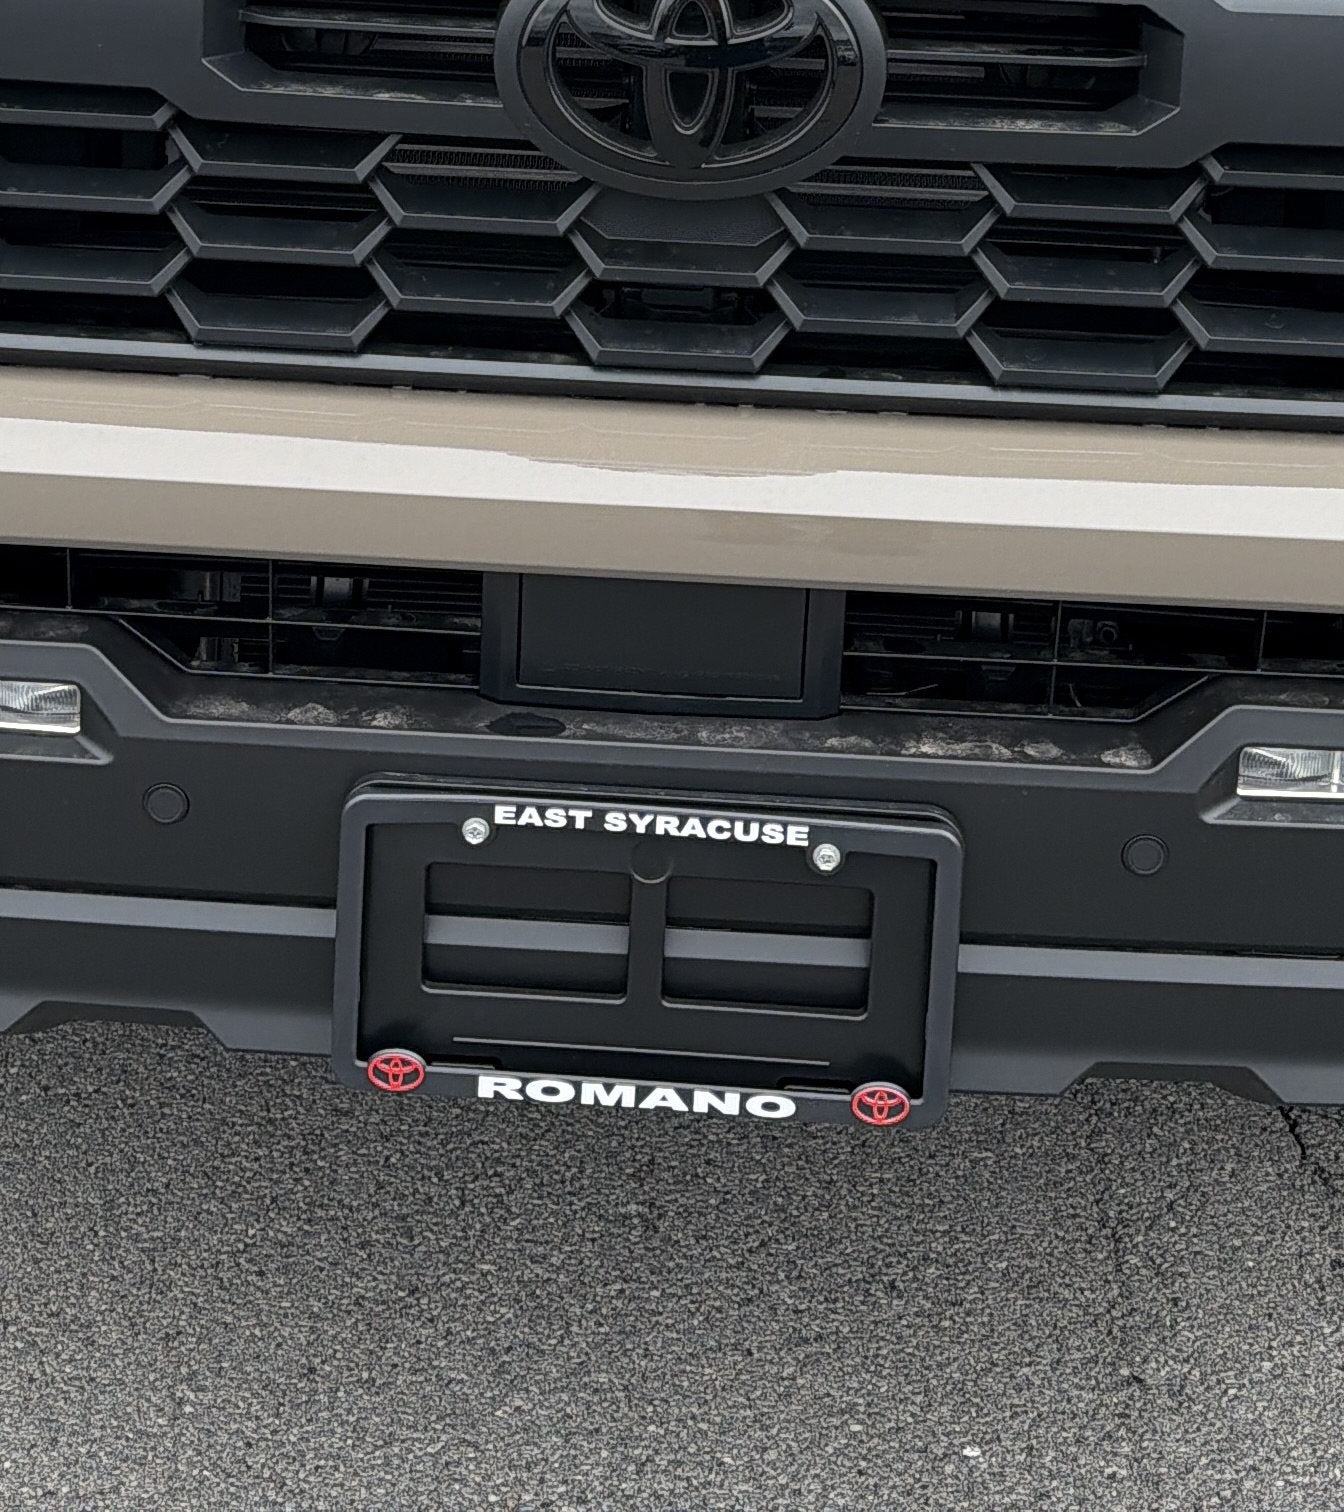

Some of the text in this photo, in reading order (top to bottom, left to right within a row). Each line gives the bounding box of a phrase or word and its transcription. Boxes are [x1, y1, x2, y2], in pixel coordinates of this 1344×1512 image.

[494, 804, 810, 847] EAST SYRACUSE
[478, 1074, 797, 1119] ROMANO
